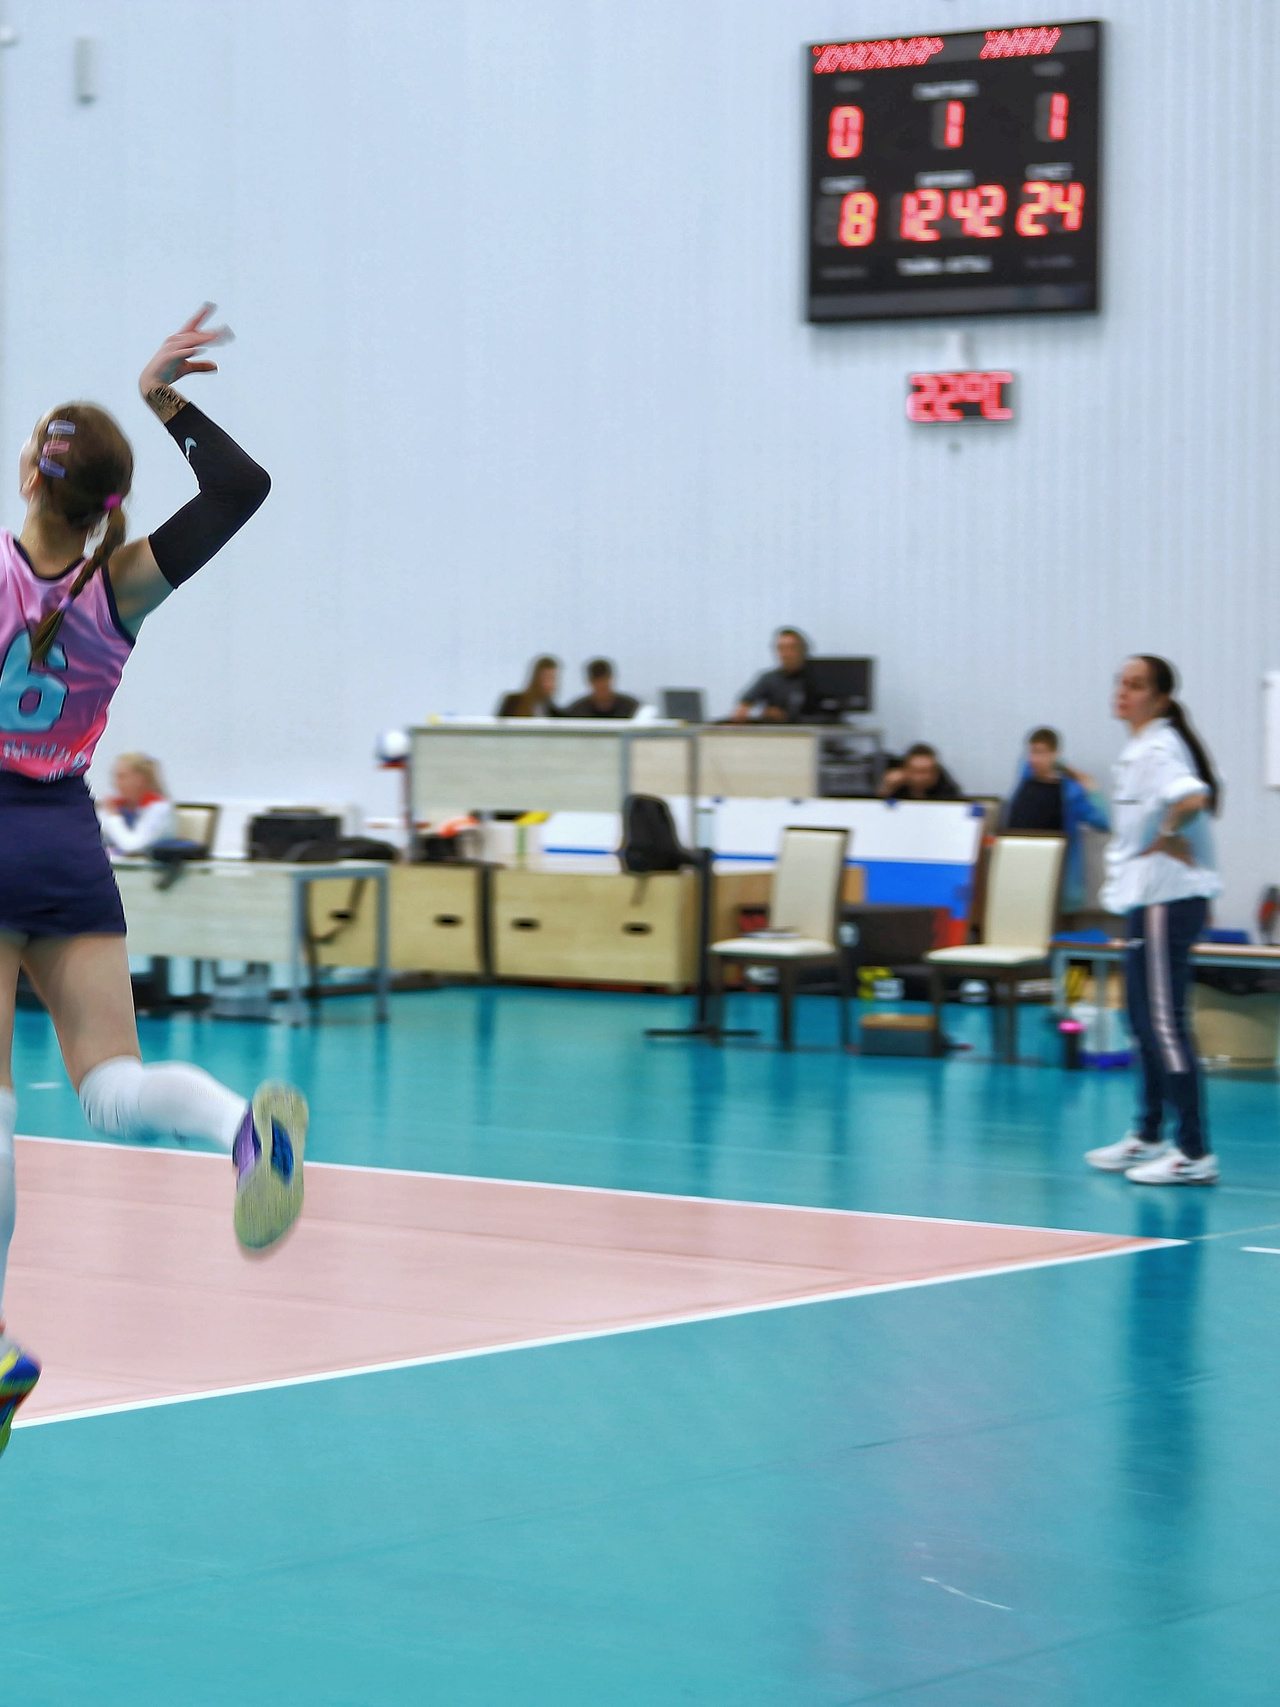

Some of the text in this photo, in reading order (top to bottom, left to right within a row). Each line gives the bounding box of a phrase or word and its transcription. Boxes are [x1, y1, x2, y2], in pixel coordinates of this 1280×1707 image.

[829, 106, 863, 158] 0
[945, 101, 965, 148] 1
[1049, 93, 1069, 140] 1
[838, 191, 878, 247] 8
[1016, 181, 1085, 237] 24
